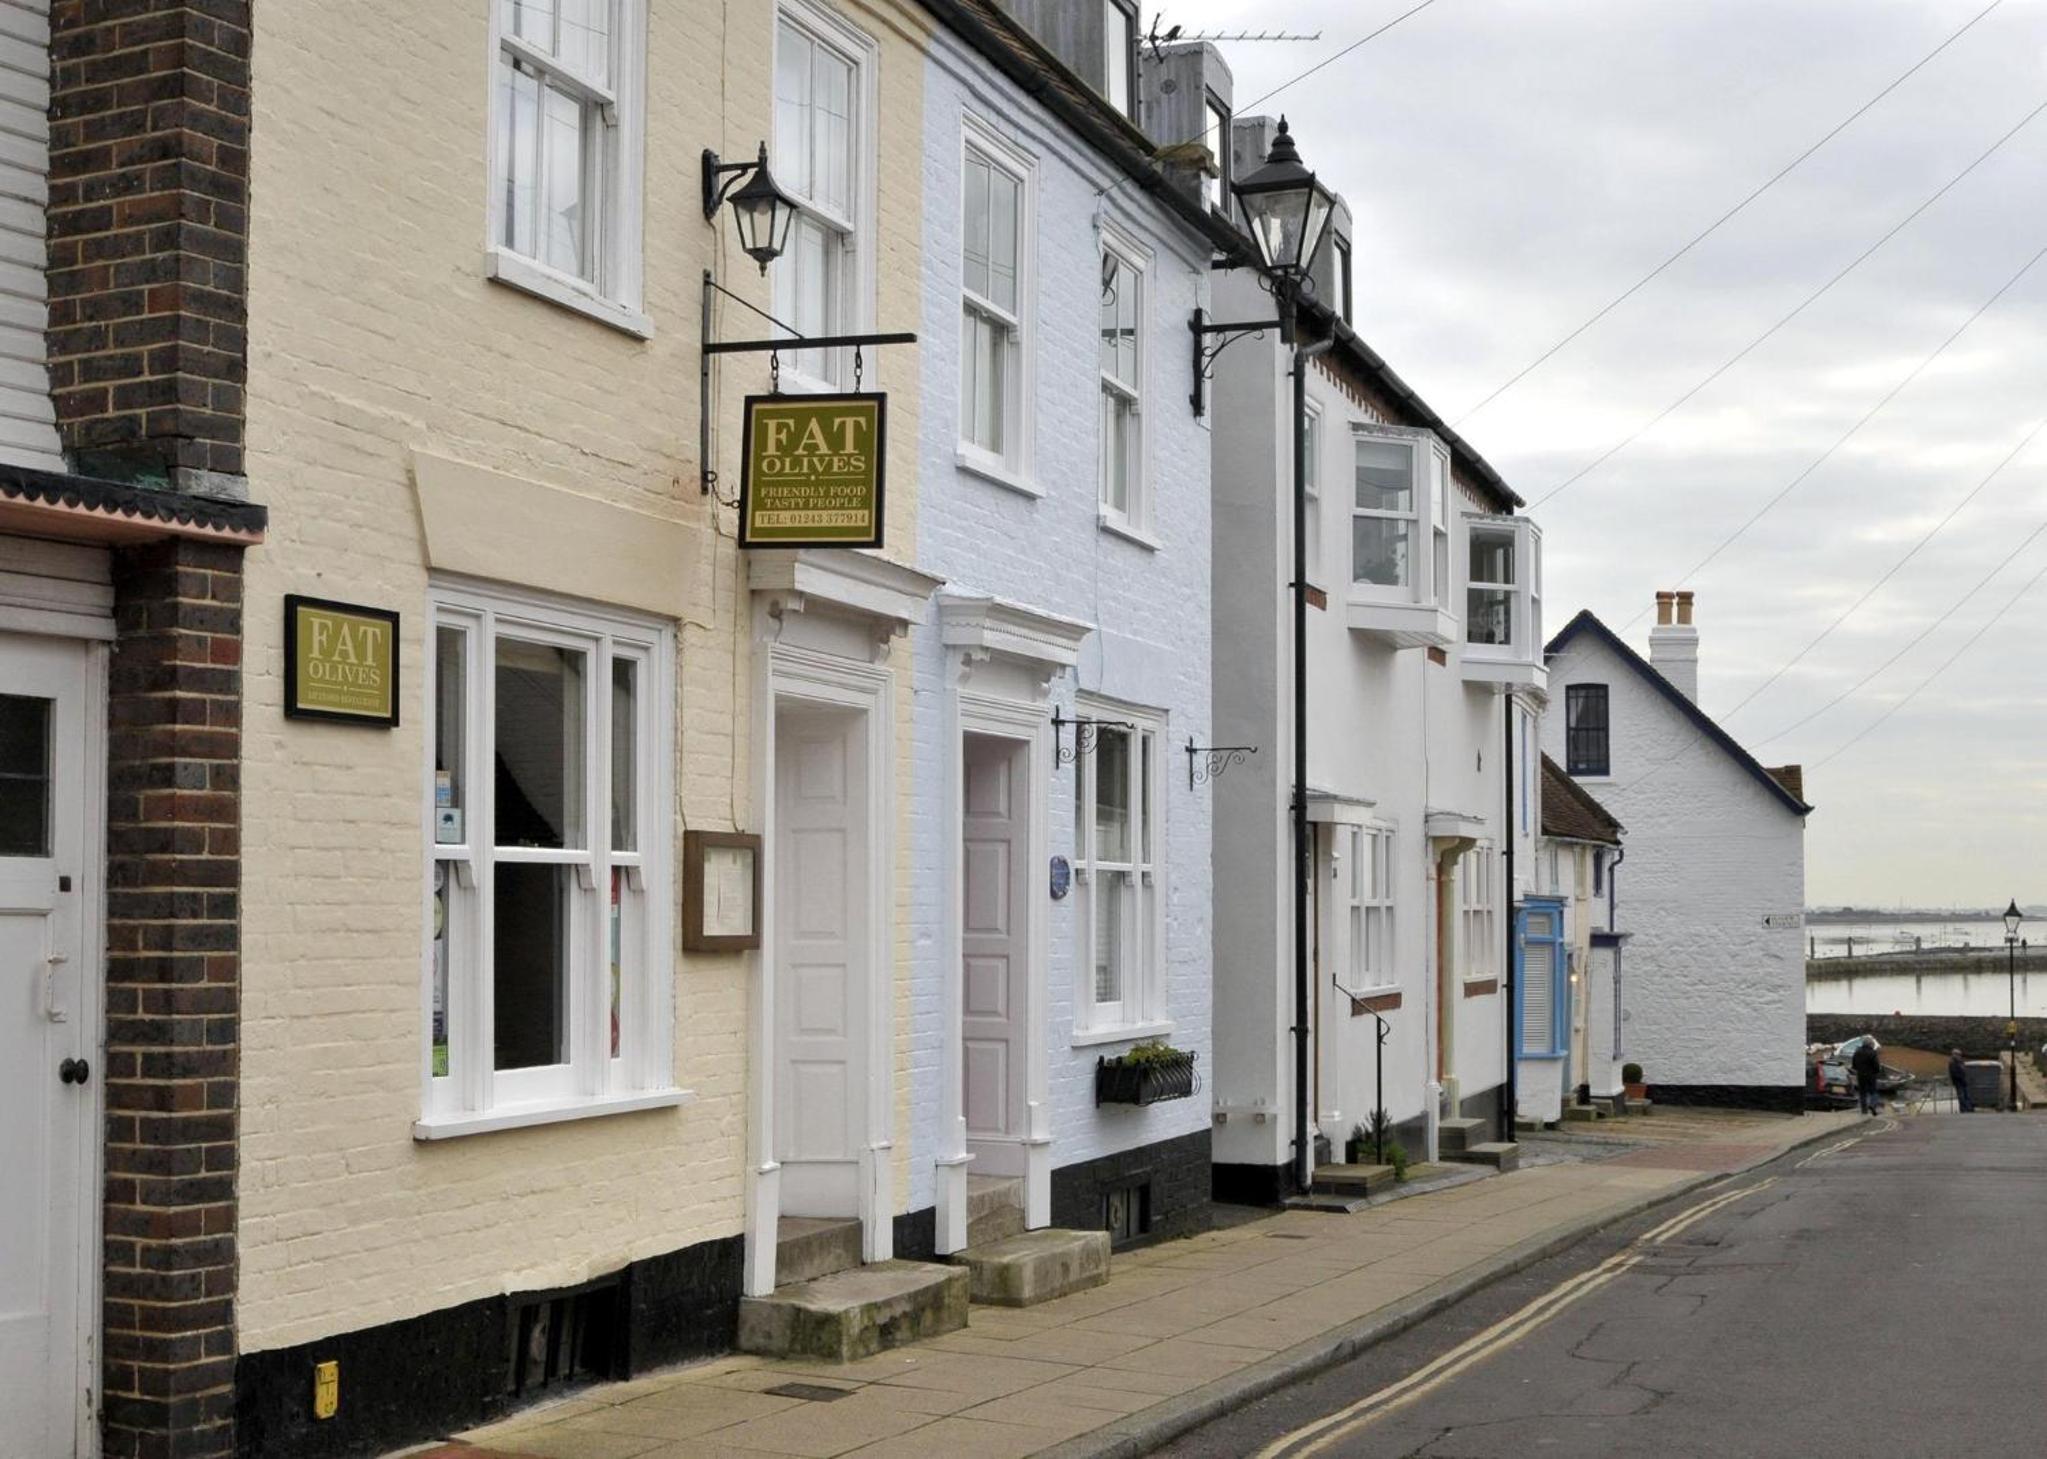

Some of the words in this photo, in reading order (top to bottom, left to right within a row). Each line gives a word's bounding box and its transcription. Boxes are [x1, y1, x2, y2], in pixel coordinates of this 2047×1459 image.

[762, 416, 867, 456] FAT
[761, 456, 866, 474] OLIVES
[761, 486, 827, 497] FRIENDLY
[830, 485, 866, 497] FOOD
[765, 498, 808, 509] TASTY
[809, 497, 862, 508] PEOPLE
[760, 513, 787, 525] TEL:
[790, 513, 823, 524] 01243
[826, 512, 866, 523] 377914
[308, 617, 381, 667] FAT
[309, 661, 381, 686] OLIVES
